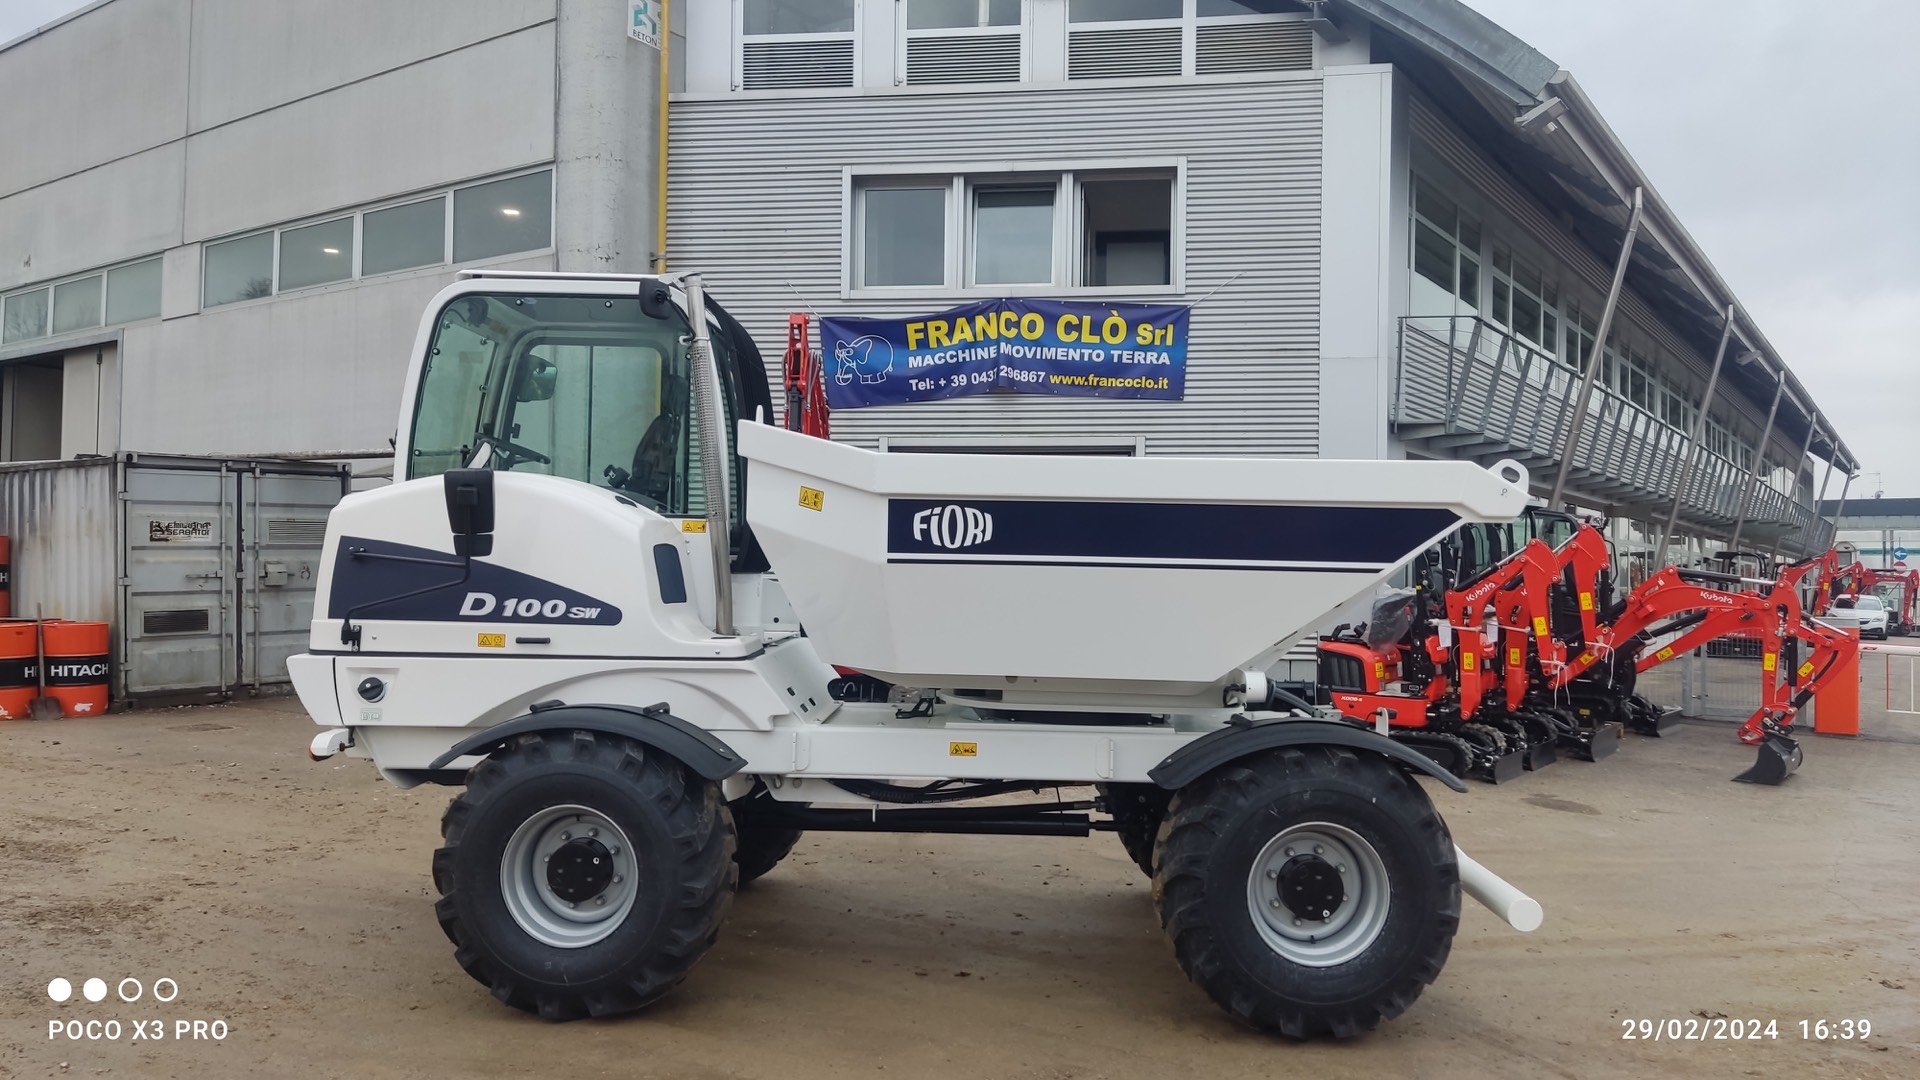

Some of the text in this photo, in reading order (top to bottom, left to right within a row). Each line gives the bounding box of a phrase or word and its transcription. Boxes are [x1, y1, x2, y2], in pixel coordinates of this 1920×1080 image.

[632, 29, 658, 47] BETON
[906, 310, 1174, 351] FRANCO CLÒ Srl
[908, 341, 1171, 369] MACCHINE MOVIMENTO TERRA
[909, 378, 935, 391] Tel:
[950, 375, 967, 387] 39
[1000, 365, 1046, 383] 296867
[1049, 373, 1169, 389] www.francoclo.it
[459, 592, 497, 616] D
[501, 597, 567, 618] 100
[1465, 582, 1496, 602] Kubota
[1700, 590, 1733, 605] Kubota
